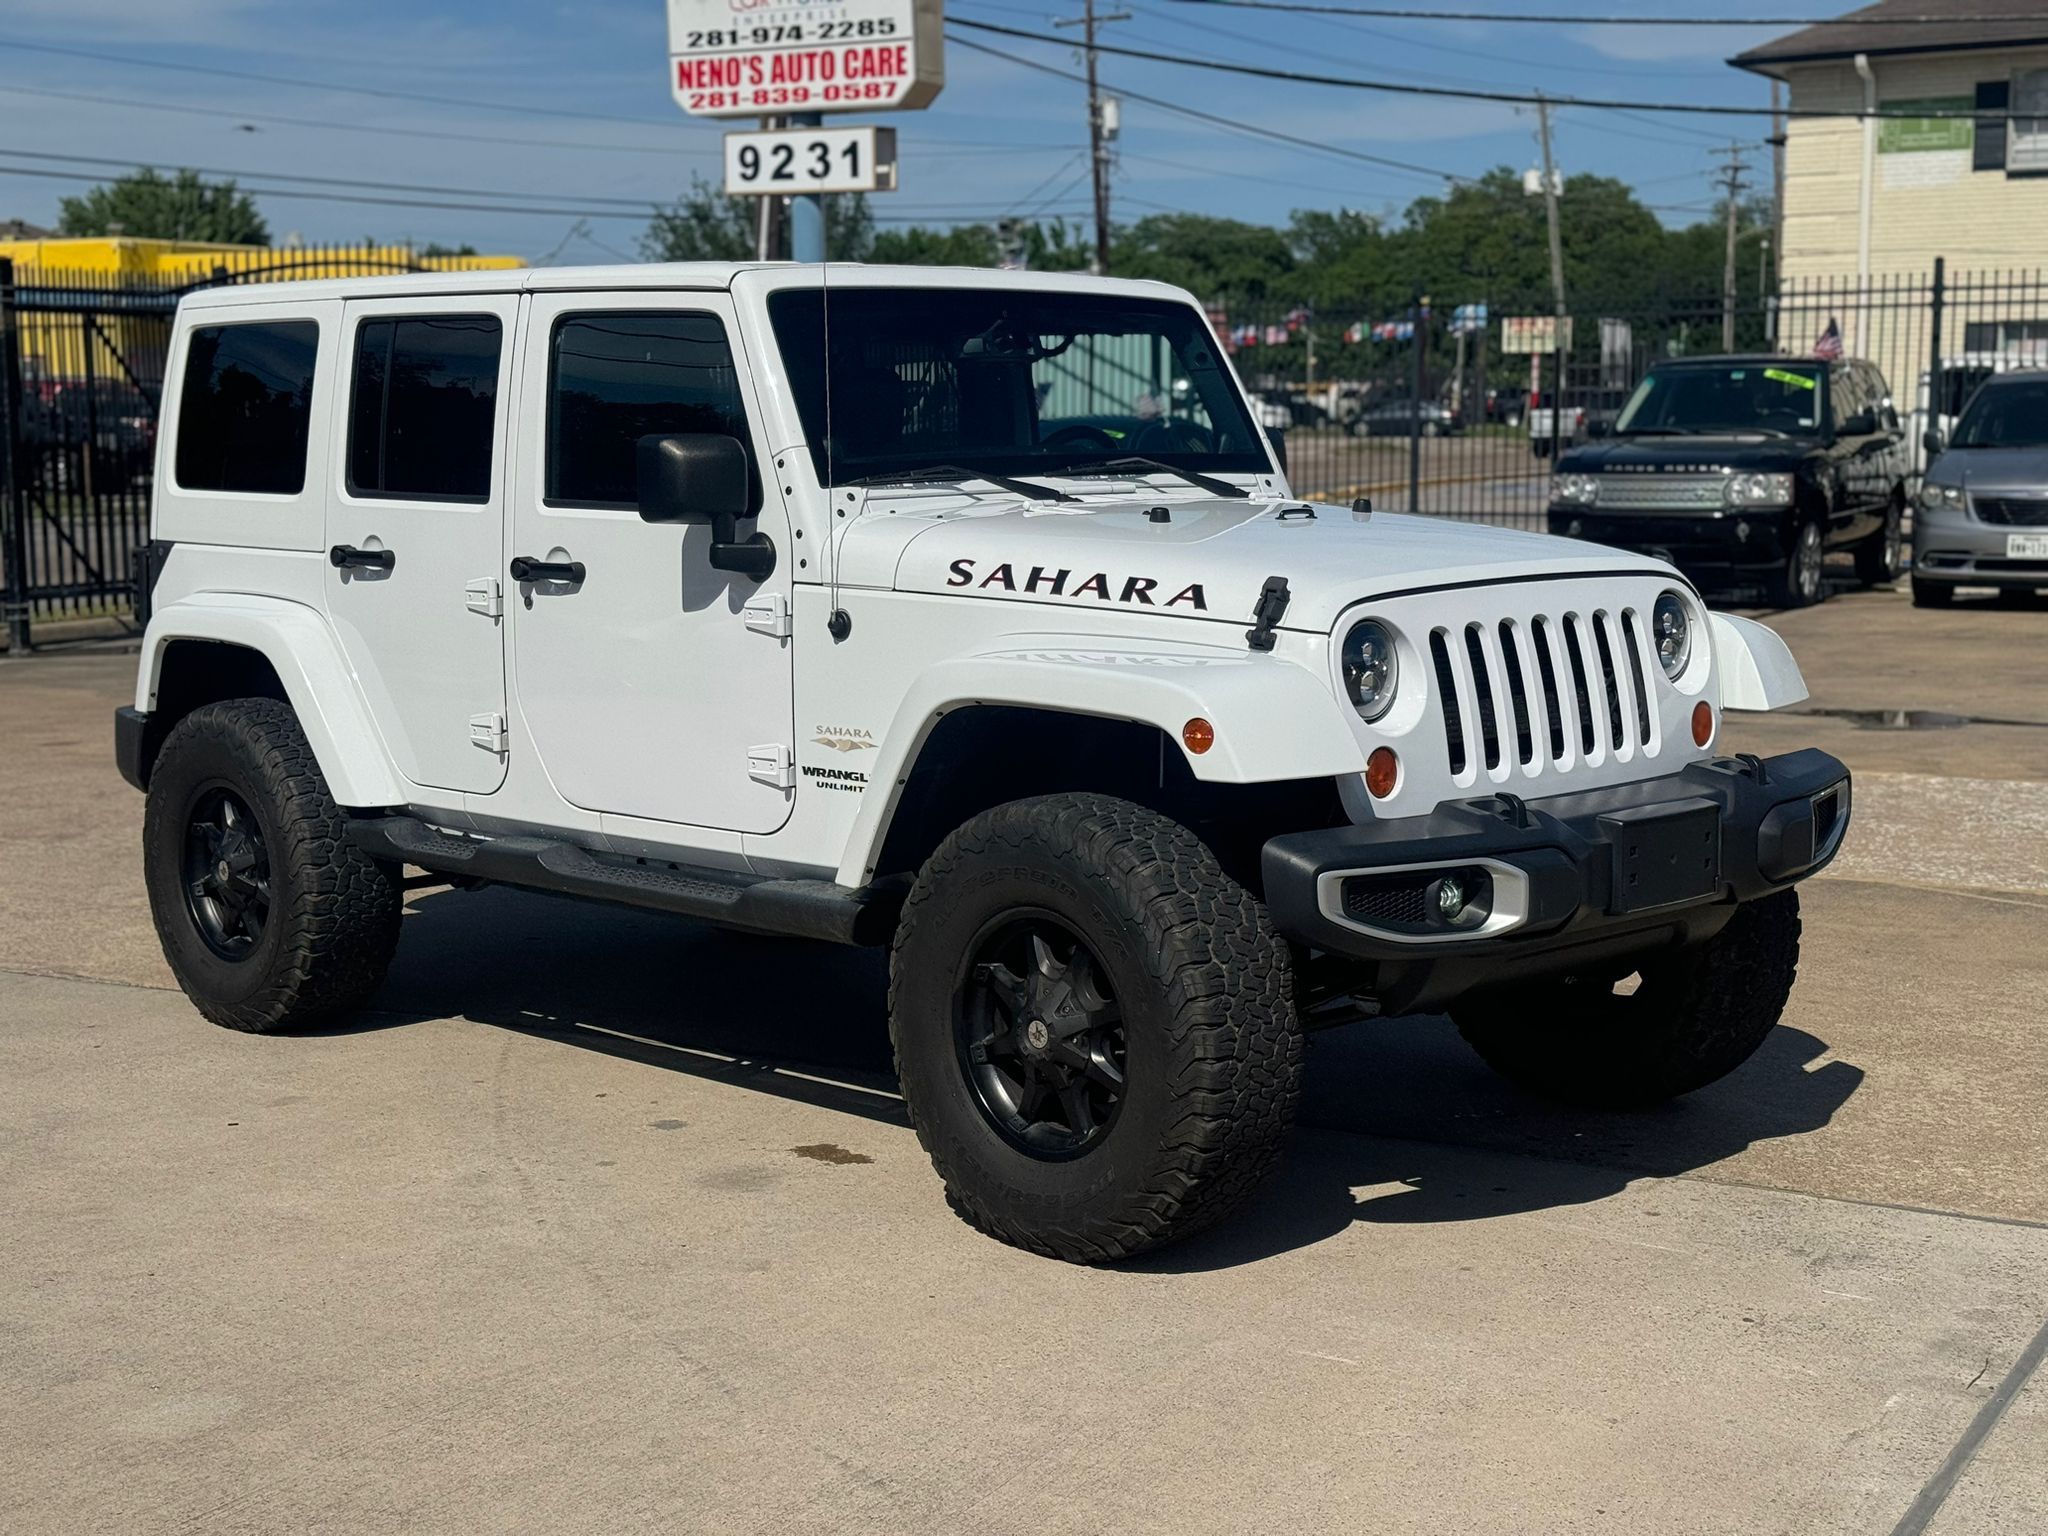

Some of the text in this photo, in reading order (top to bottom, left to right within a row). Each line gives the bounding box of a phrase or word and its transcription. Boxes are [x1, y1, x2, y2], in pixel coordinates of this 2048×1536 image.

[687, 18, 896, 47] 281-974-2285
[678, 45, 907, 90] NENO'S AUTO CARE
[690, 82, 897, 109] 281-839-0587
[739, 140, 859, 181] 9231
[946, 559, 1208, 611] SAHARA
[816, 725, 872, 738] SAHARA
[802, 766, 869, 782] WRANGL
